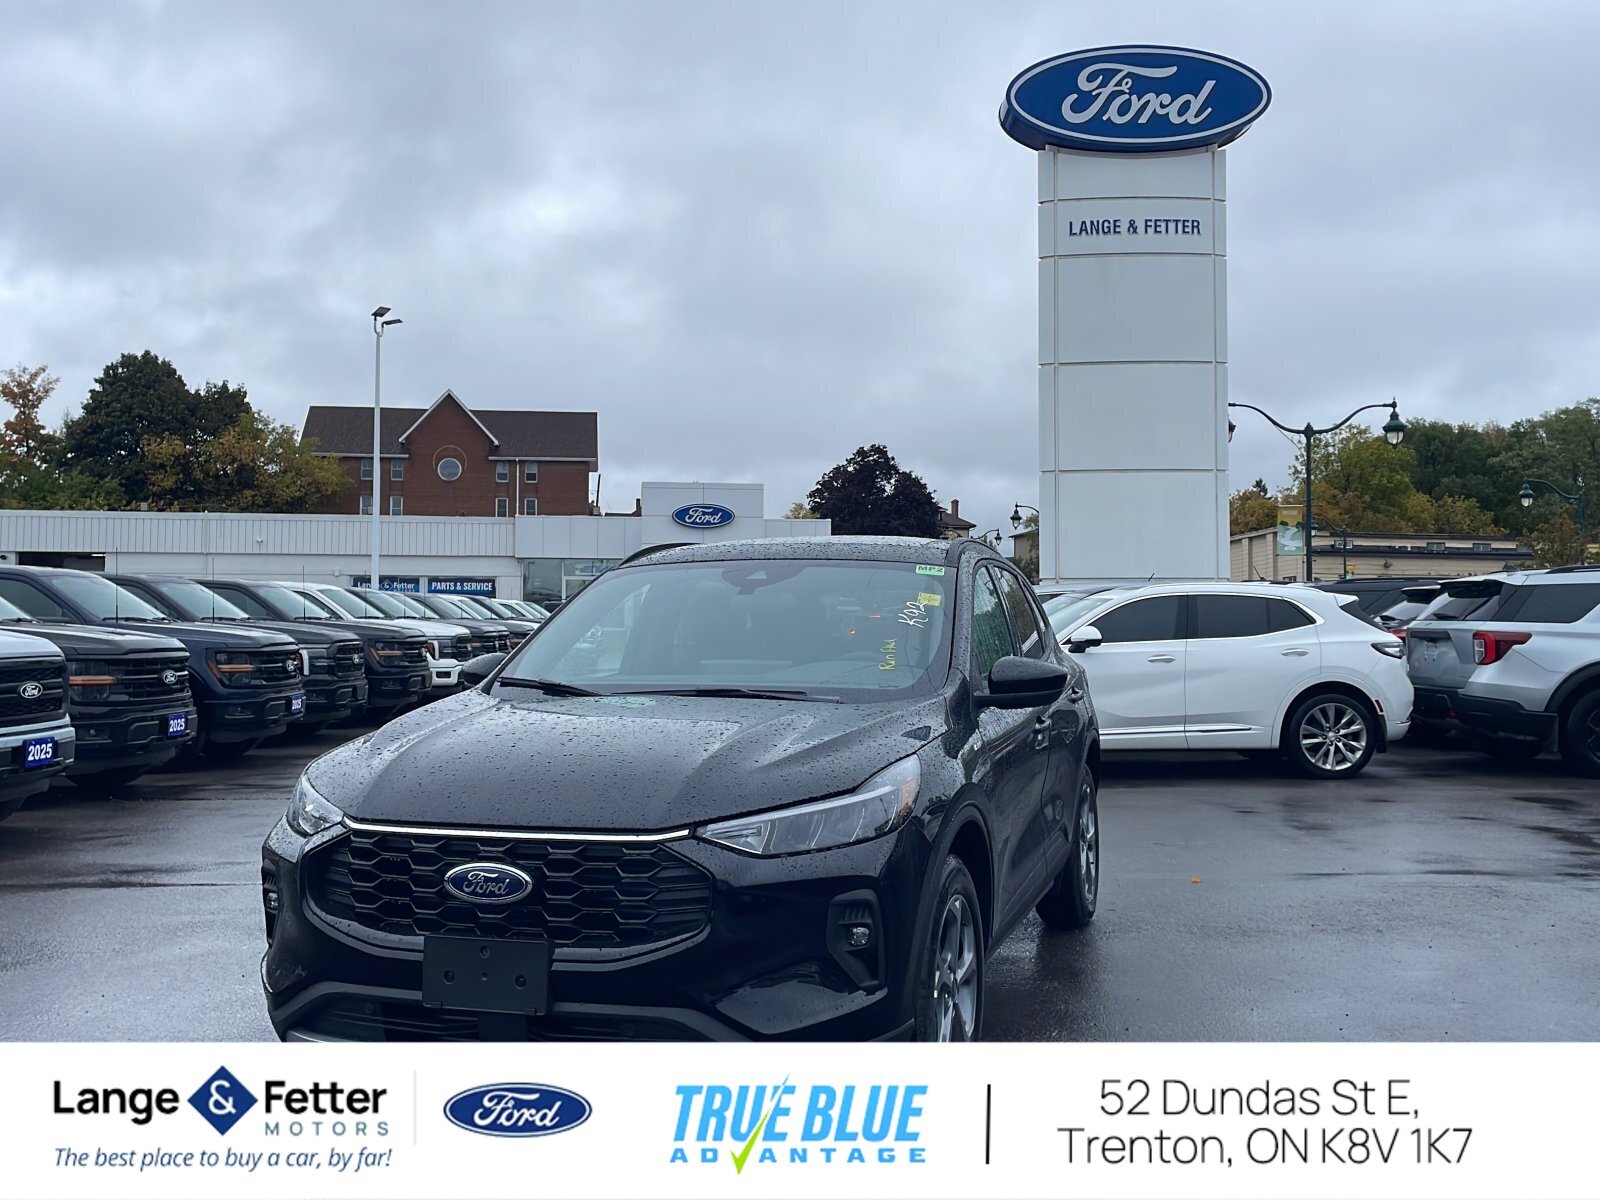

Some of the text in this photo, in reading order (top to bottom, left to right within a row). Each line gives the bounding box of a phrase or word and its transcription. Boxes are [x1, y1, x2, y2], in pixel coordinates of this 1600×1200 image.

[1061, 62, 1216, 125] Ford
[1068, 218, 1202, 237] LANGE & FETTER
[685, 507, 722, 524] Ford
[393, 582, 415, 590] Fetter
[431, 581, 493, 592] PARTS & SERVICE
[24, 685, 40, 697] Ford
[169, 718, 186, 733] 2025
[27, 743, 53, 761] 2025
[463, 871, 510, 895] Ford
